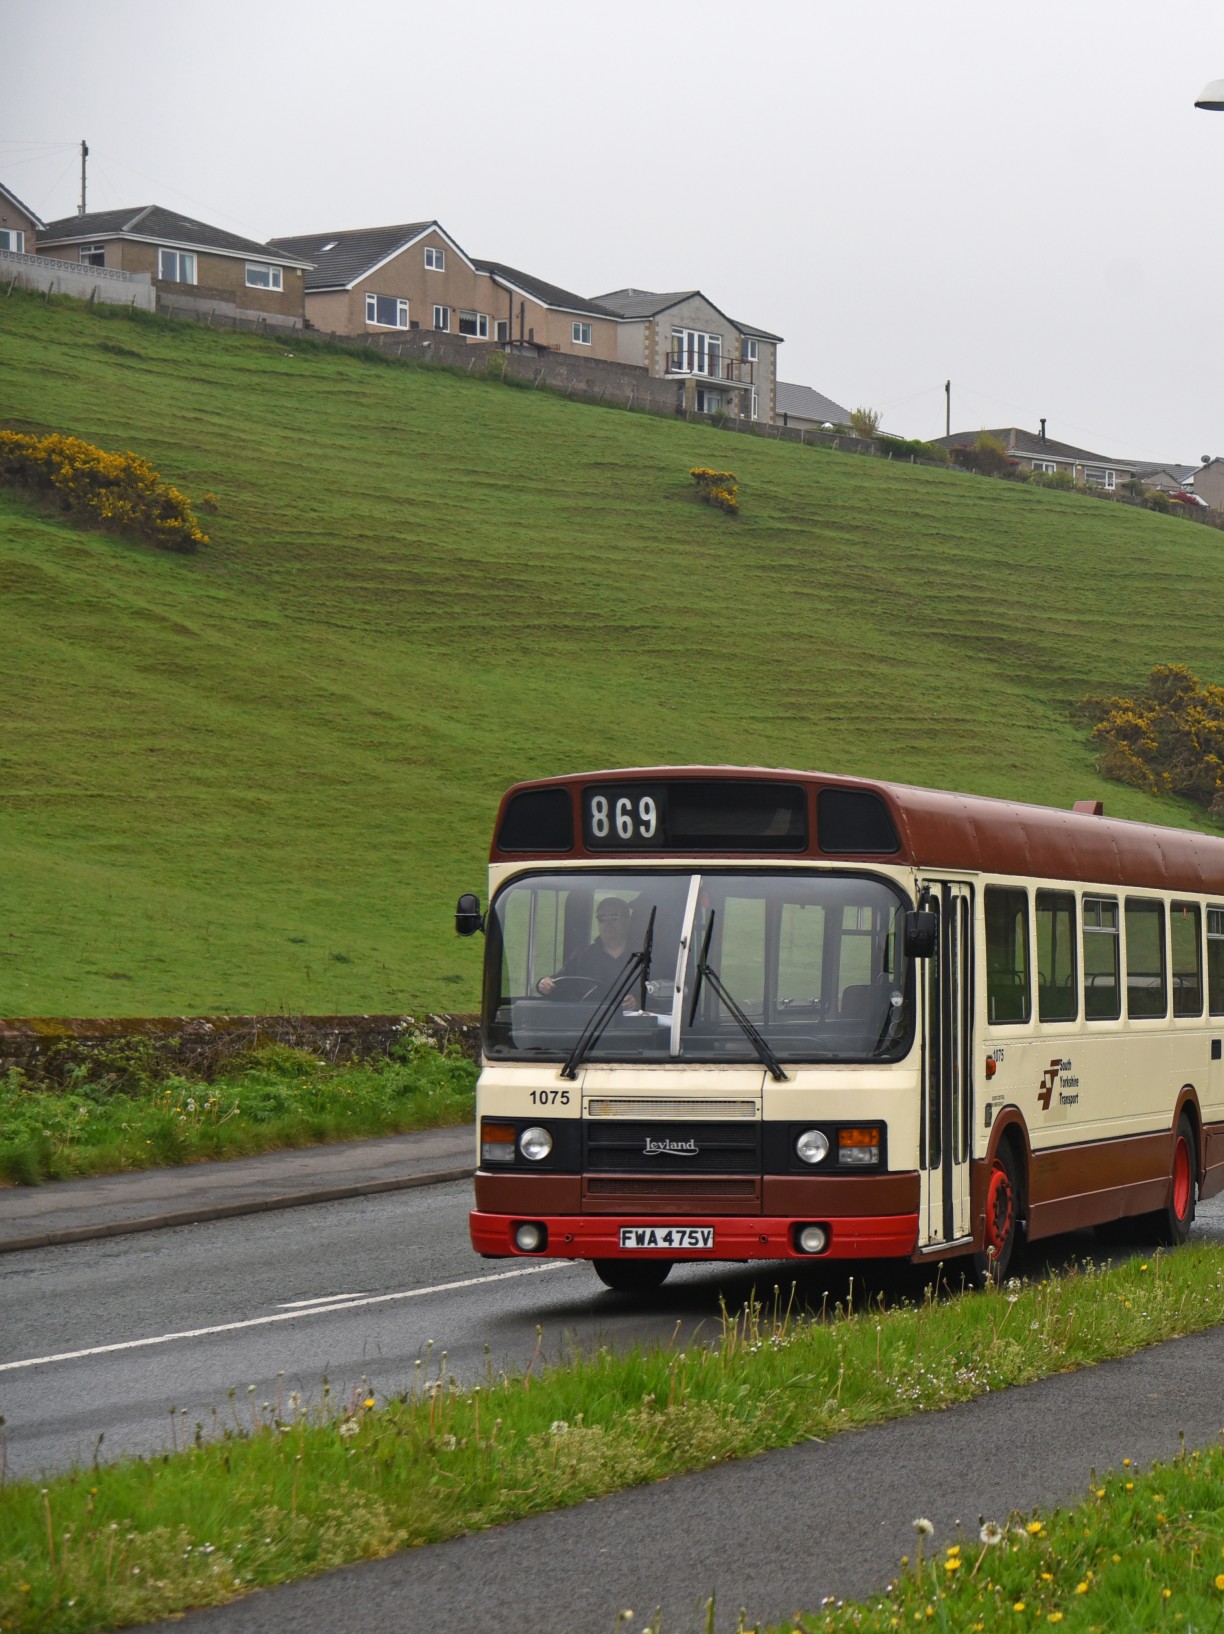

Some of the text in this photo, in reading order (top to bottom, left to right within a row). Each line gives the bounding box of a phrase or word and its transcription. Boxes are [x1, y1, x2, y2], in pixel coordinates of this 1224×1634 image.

[590, 795, 657, 840] 869
[992, 1048, 1005, 1062] 1075
[1059, 1058, 1072, 1071] South
[1059, 1075, 1080, 1088] Yorkshire
[529, 1090, 570, 1105] 1075
[1059, 1092, 1079, 1107] Transport
[642, 1137, 699, 1156] Leyland
[621, 1229, 712, 1247] FWA 475V
